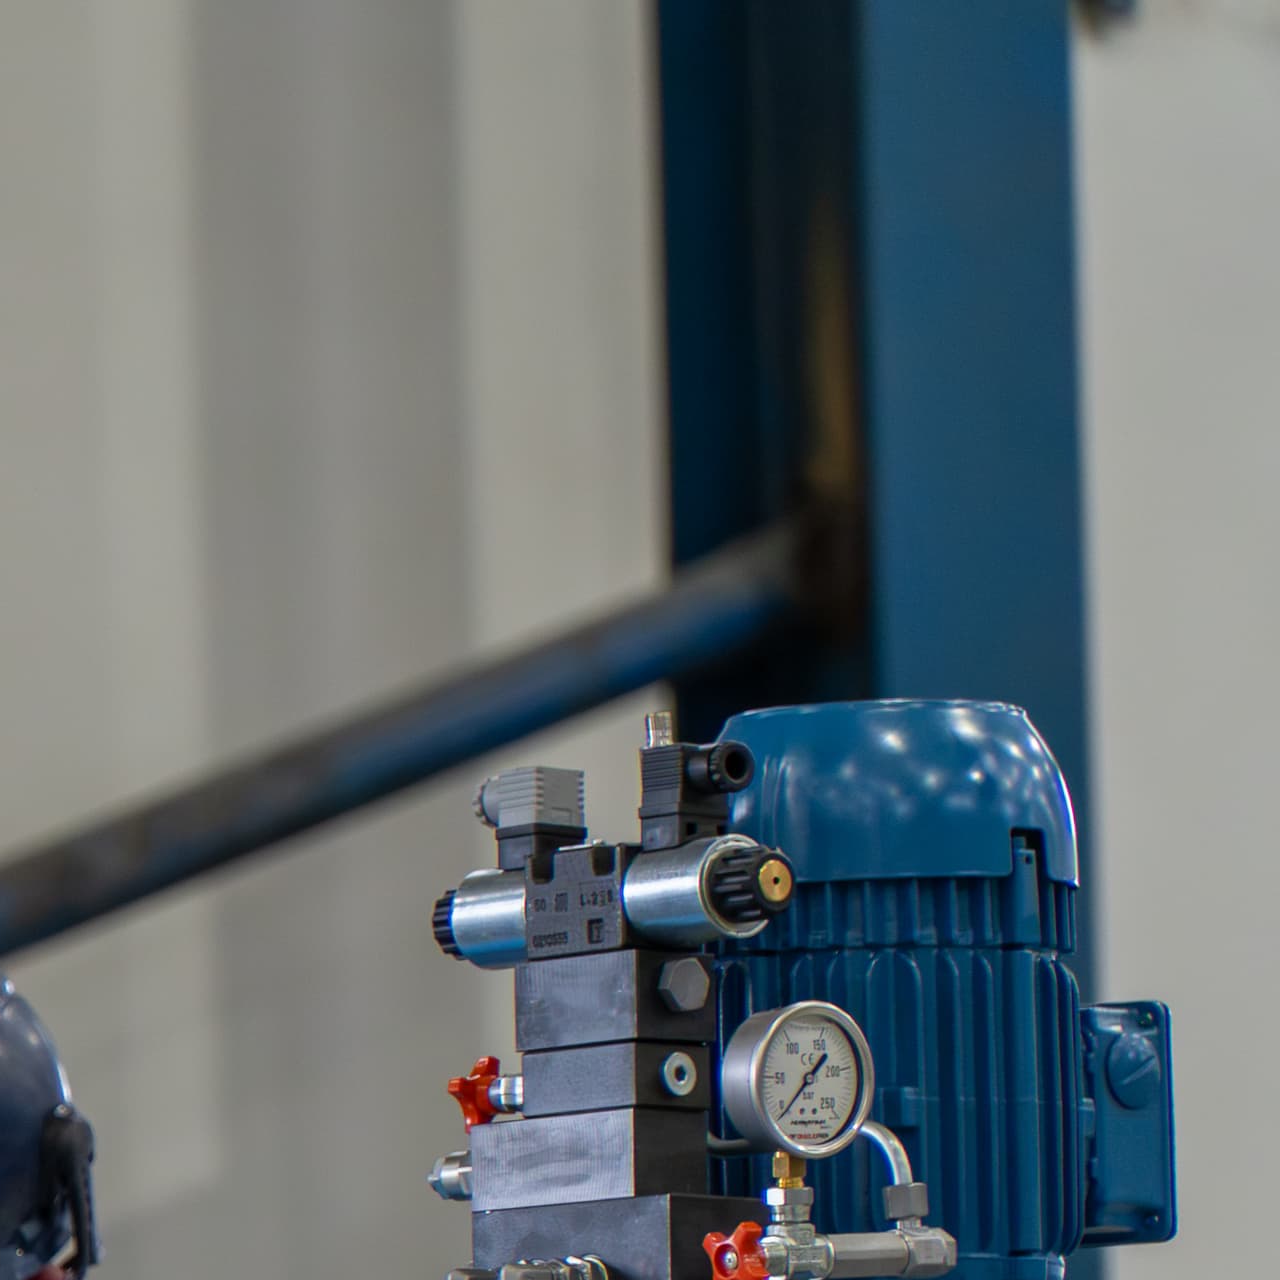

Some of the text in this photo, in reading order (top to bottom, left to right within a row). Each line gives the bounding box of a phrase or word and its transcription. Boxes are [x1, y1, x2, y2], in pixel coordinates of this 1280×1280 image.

[786, 1042, 800, 1055] 100
[813, 1039, 826, 1052] 150
[825, 1065, 840, 1078] 200
[775, 1072, 785, 1085] 50
[821, 1097, 836, 1110] 250
